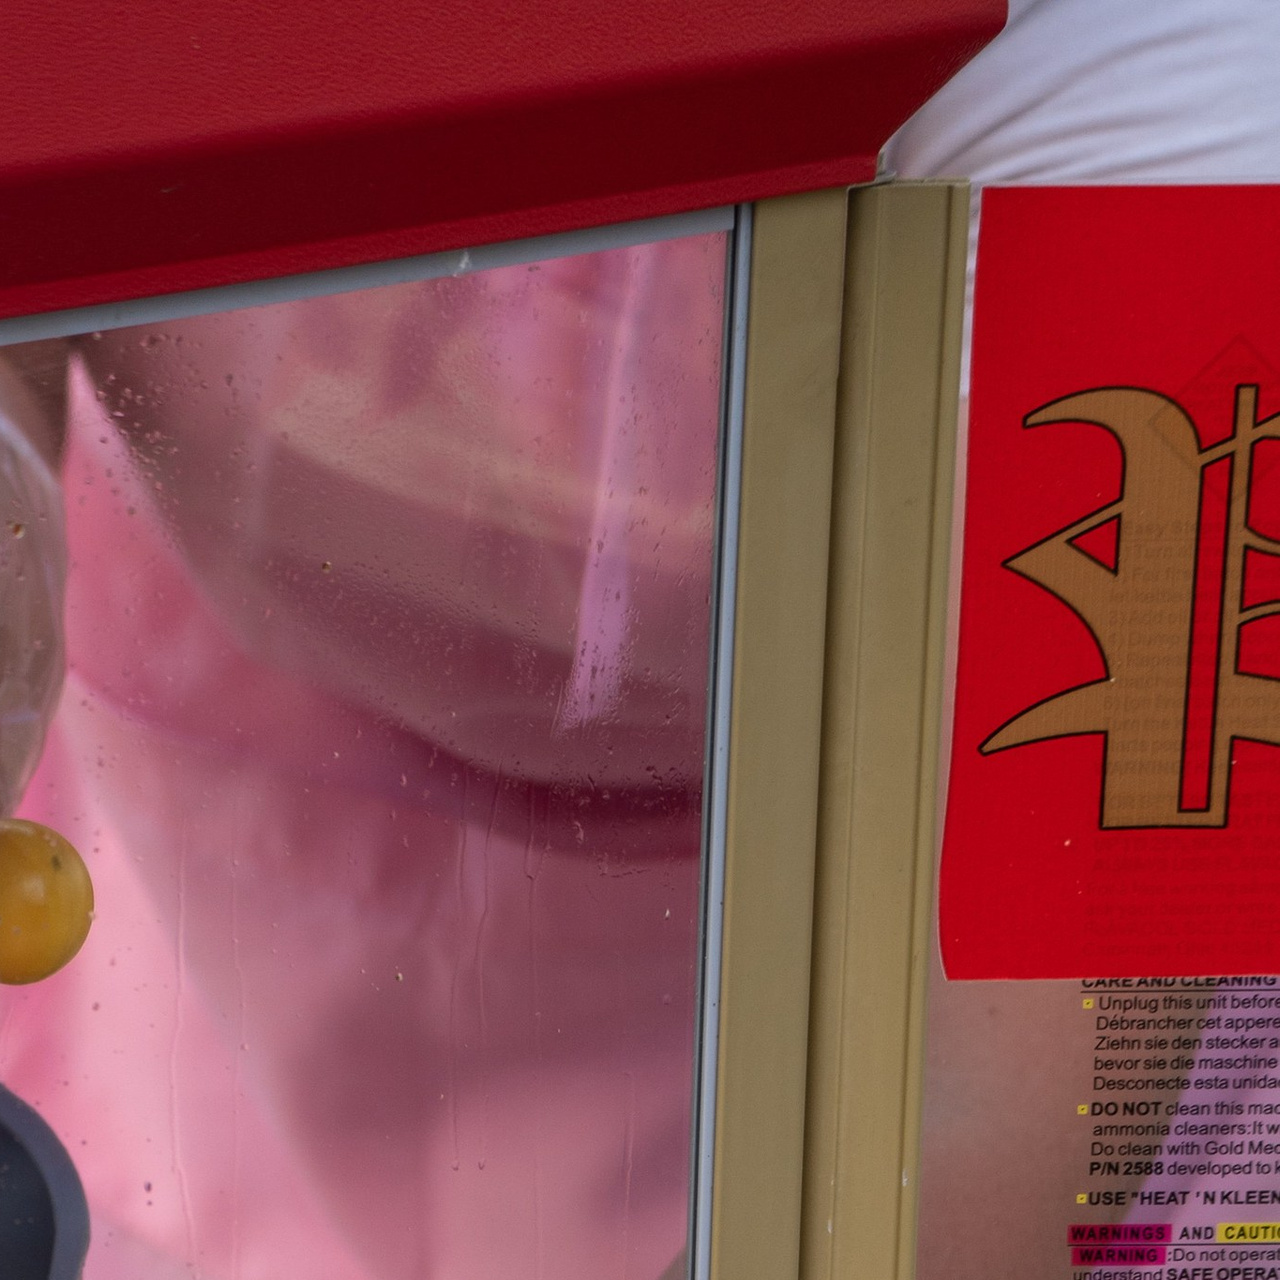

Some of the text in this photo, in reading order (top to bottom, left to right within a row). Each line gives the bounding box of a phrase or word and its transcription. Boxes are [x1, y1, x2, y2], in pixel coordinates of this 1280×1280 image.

[1082, 976, 1277, 988] CARE AND CLEANING
[1099, 997, 1158, 1013] Unplug
[1162, 996, 1192, 1010] this
[1196, 996, 1227, 1009] unit
[1096, 1015, 1193, 1030] Débrancher
[1196, 1017, 1222, 1029] cet
[1095, 1034, 1267, 1051] Ziehn sie den stecker
[1094, 1054, 1278, 1070] bevor sie die maschine
[1093, 1076, 1191, 1091] Desconecte
[1194, 1076, 1229, 1090] esta
[1091, 1102, 1119, 1116] DO
[1122, 1102, 1162, 1116] NOT
[1165, 1101, 1211, 1116] clean
[1214, 1100, 1245, 1115] this
[1093, 1123, 1170, 1136] ammonia
[1091, 1141, 1244, 1156] Do clean with Gold
[1089, 1160, 1271, 1177] P/N 2588 developed to
[1088, 1192, 1126, 1206] USE
[1070, 1226, 1166, 1240] WARNINGS
[1179, 1226, 1214, 1240] AND
[1079, 1249, 1158, 1262] WARNING
[1199, 1249, 1224, 1261] not
[1166, 1267, 1213, 1280] SAFE
[1216, 1267, 1280, 1280] OPERA
